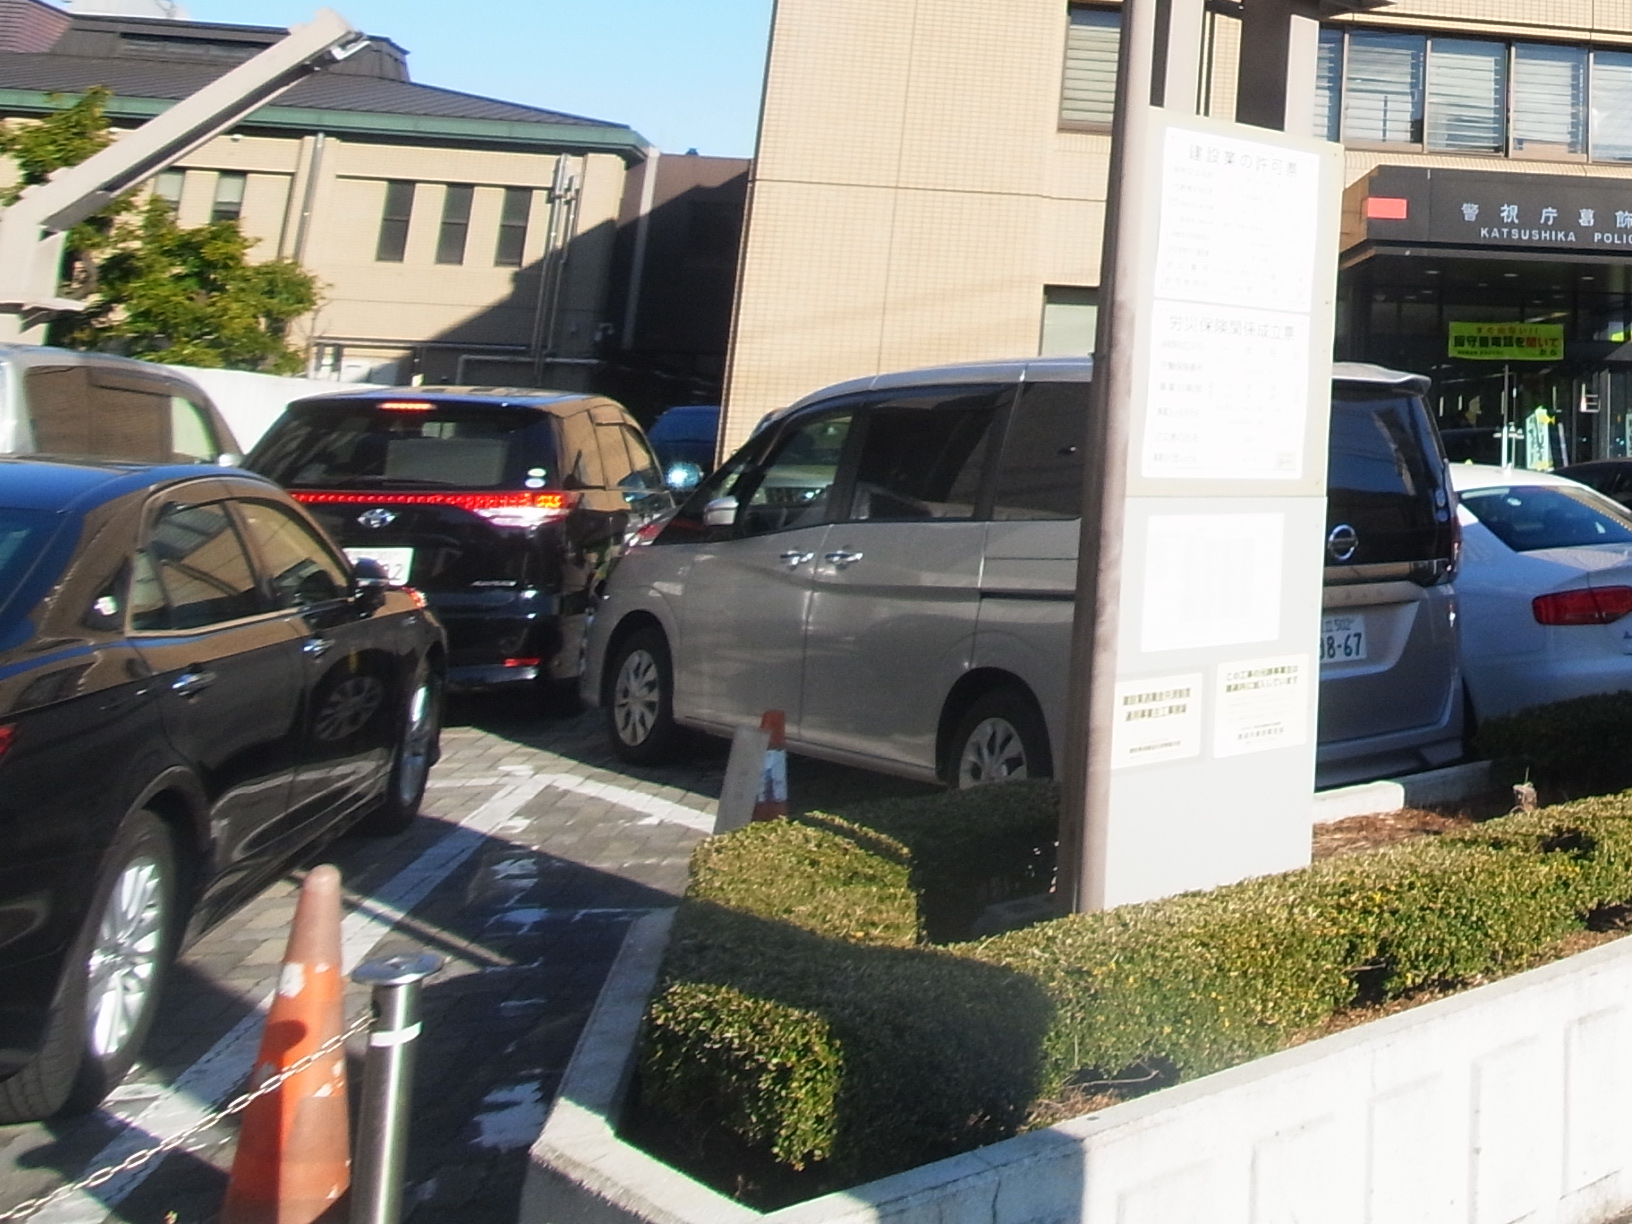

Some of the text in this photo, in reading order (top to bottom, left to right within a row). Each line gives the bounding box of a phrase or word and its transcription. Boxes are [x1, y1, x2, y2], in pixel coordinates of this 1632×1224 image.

[1189, 143, 1298, 177] 建設業の許可票
[1480, 227, 1576, 243] KATSUSHIKA
[1169, 315, 1295, 341] 労災保険関係成立票
